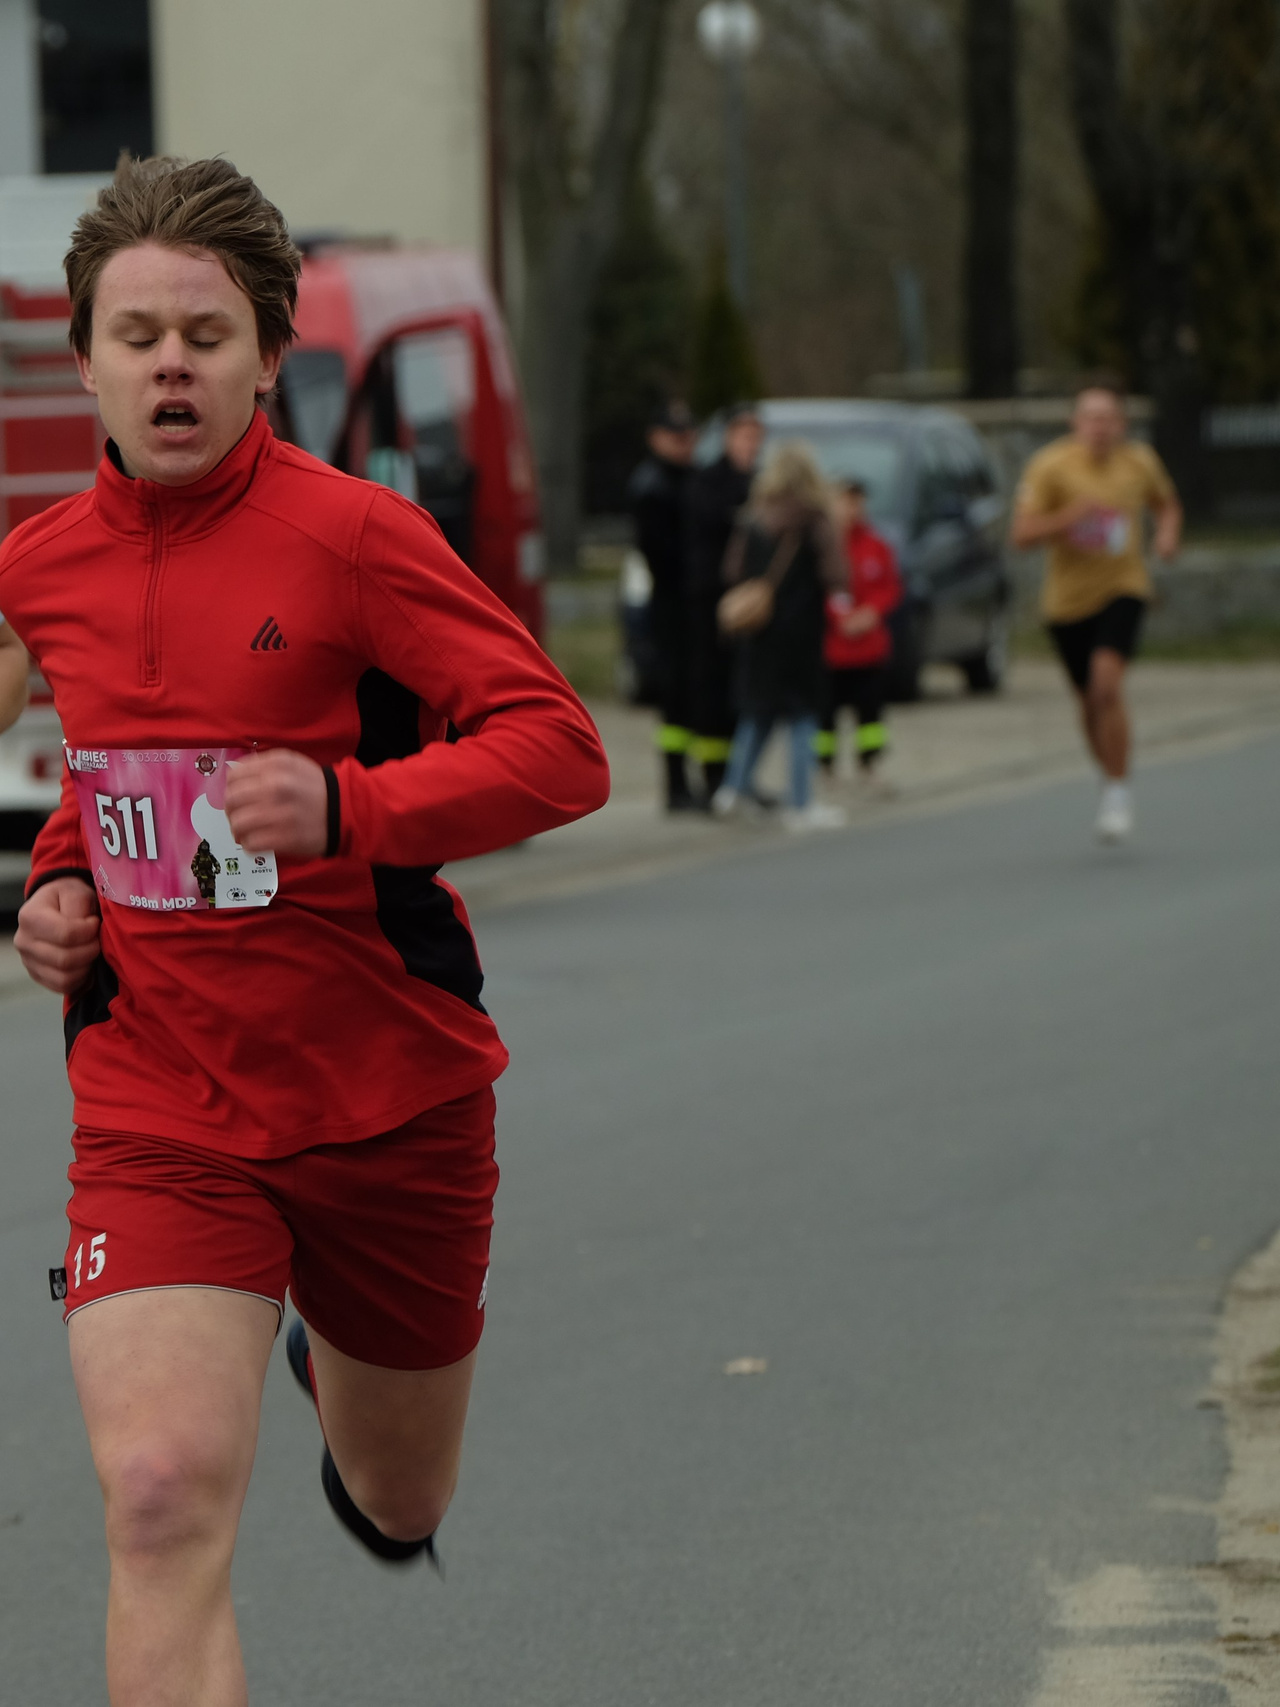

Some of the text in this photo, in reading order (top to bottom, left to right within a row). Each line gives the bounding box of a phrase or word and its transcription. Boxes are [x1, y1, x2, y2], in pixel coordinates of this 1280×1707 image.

[81, 750, 108, 763] BIEG
[121, 751, 181, 764] 30.03.2025
[95, 793, 158, 860] 511
[129, 895, 197, 910] 998m MDP
[73, 1231, 107, 1290] 15
